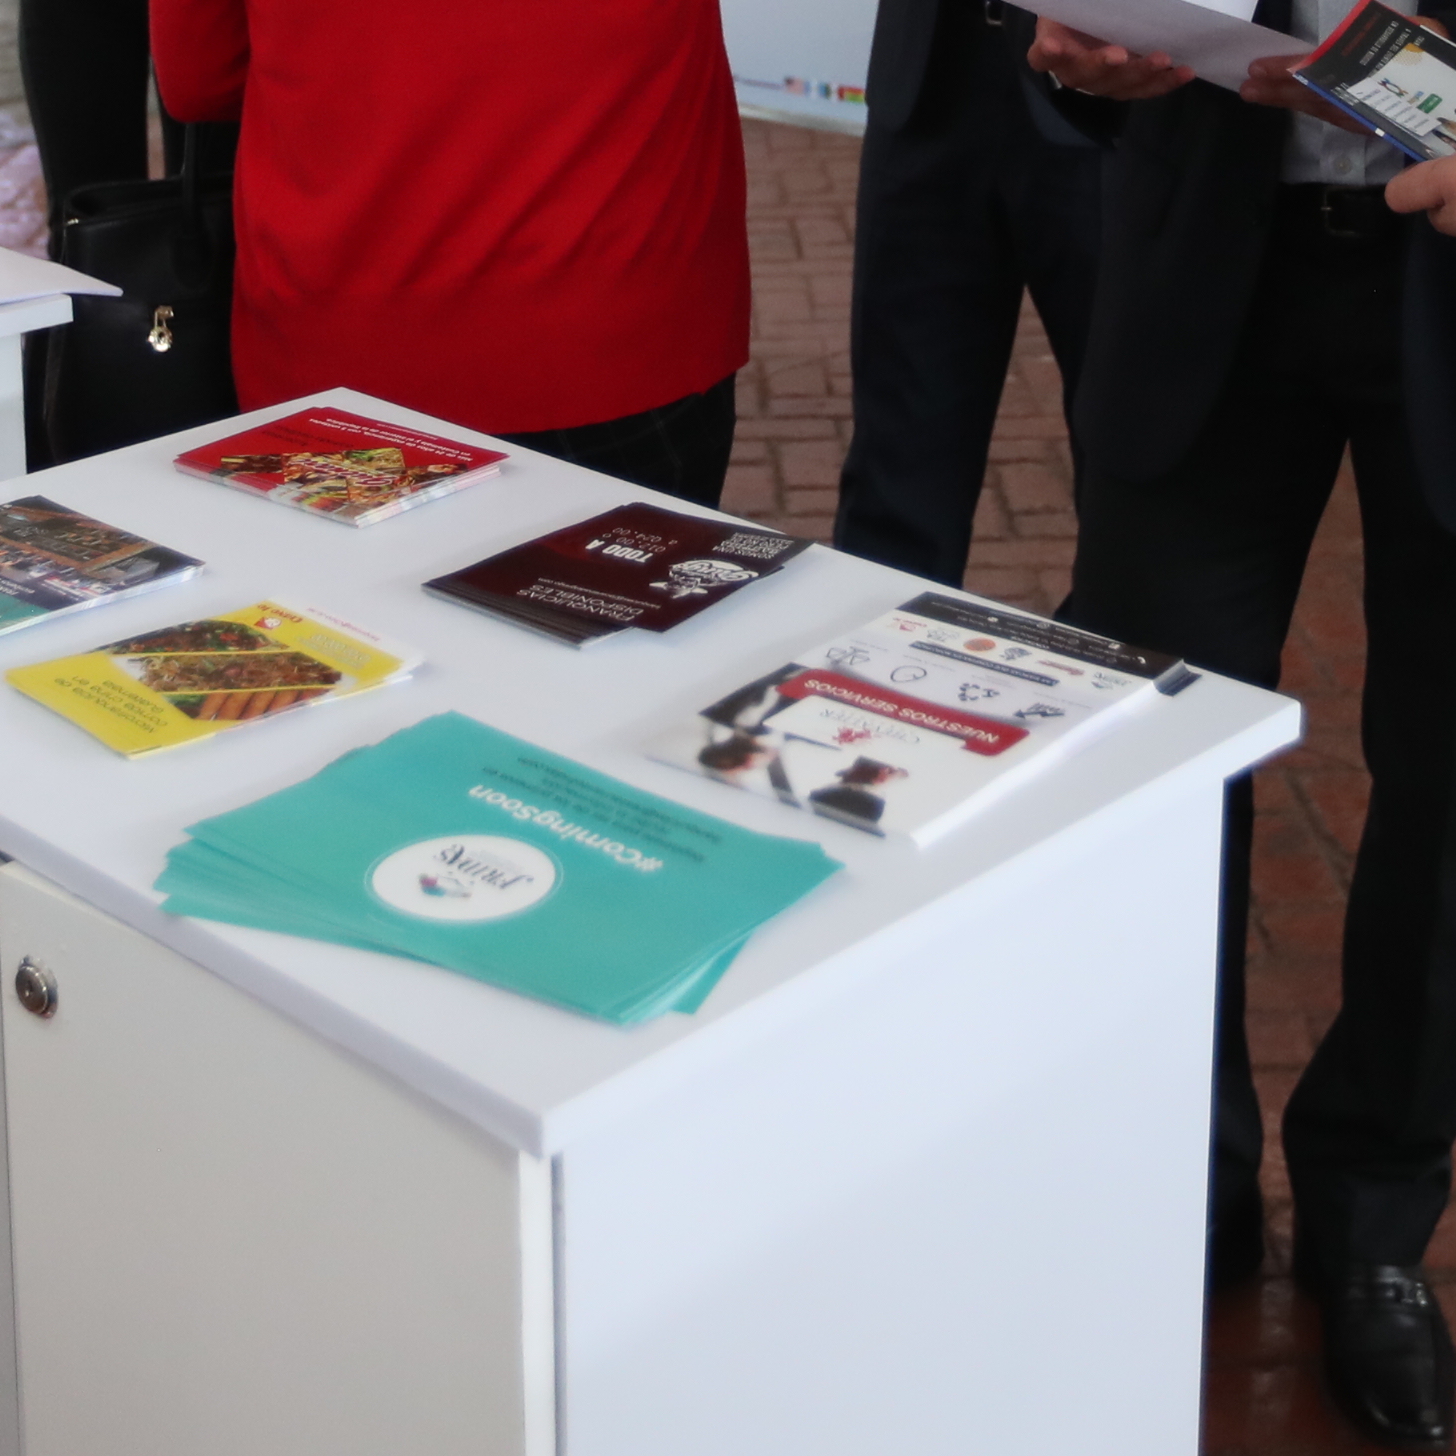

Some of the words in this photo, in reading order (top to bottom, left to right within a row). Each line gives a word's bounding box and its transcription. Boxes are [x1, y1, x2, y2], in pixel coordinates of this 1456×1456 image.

[586, 540, 604, 549] A
[603, 545, 651, 562] TODO
[518, 590, 633, 620] FRANQUICIAS
[531, 585, 642, 614] DISPONIBLES
[806, 681, 896, 710] SERVICIOS
[901, 710, 997, 742] NUESTROS
[468, 785, 663, 871] #ComingSoon
